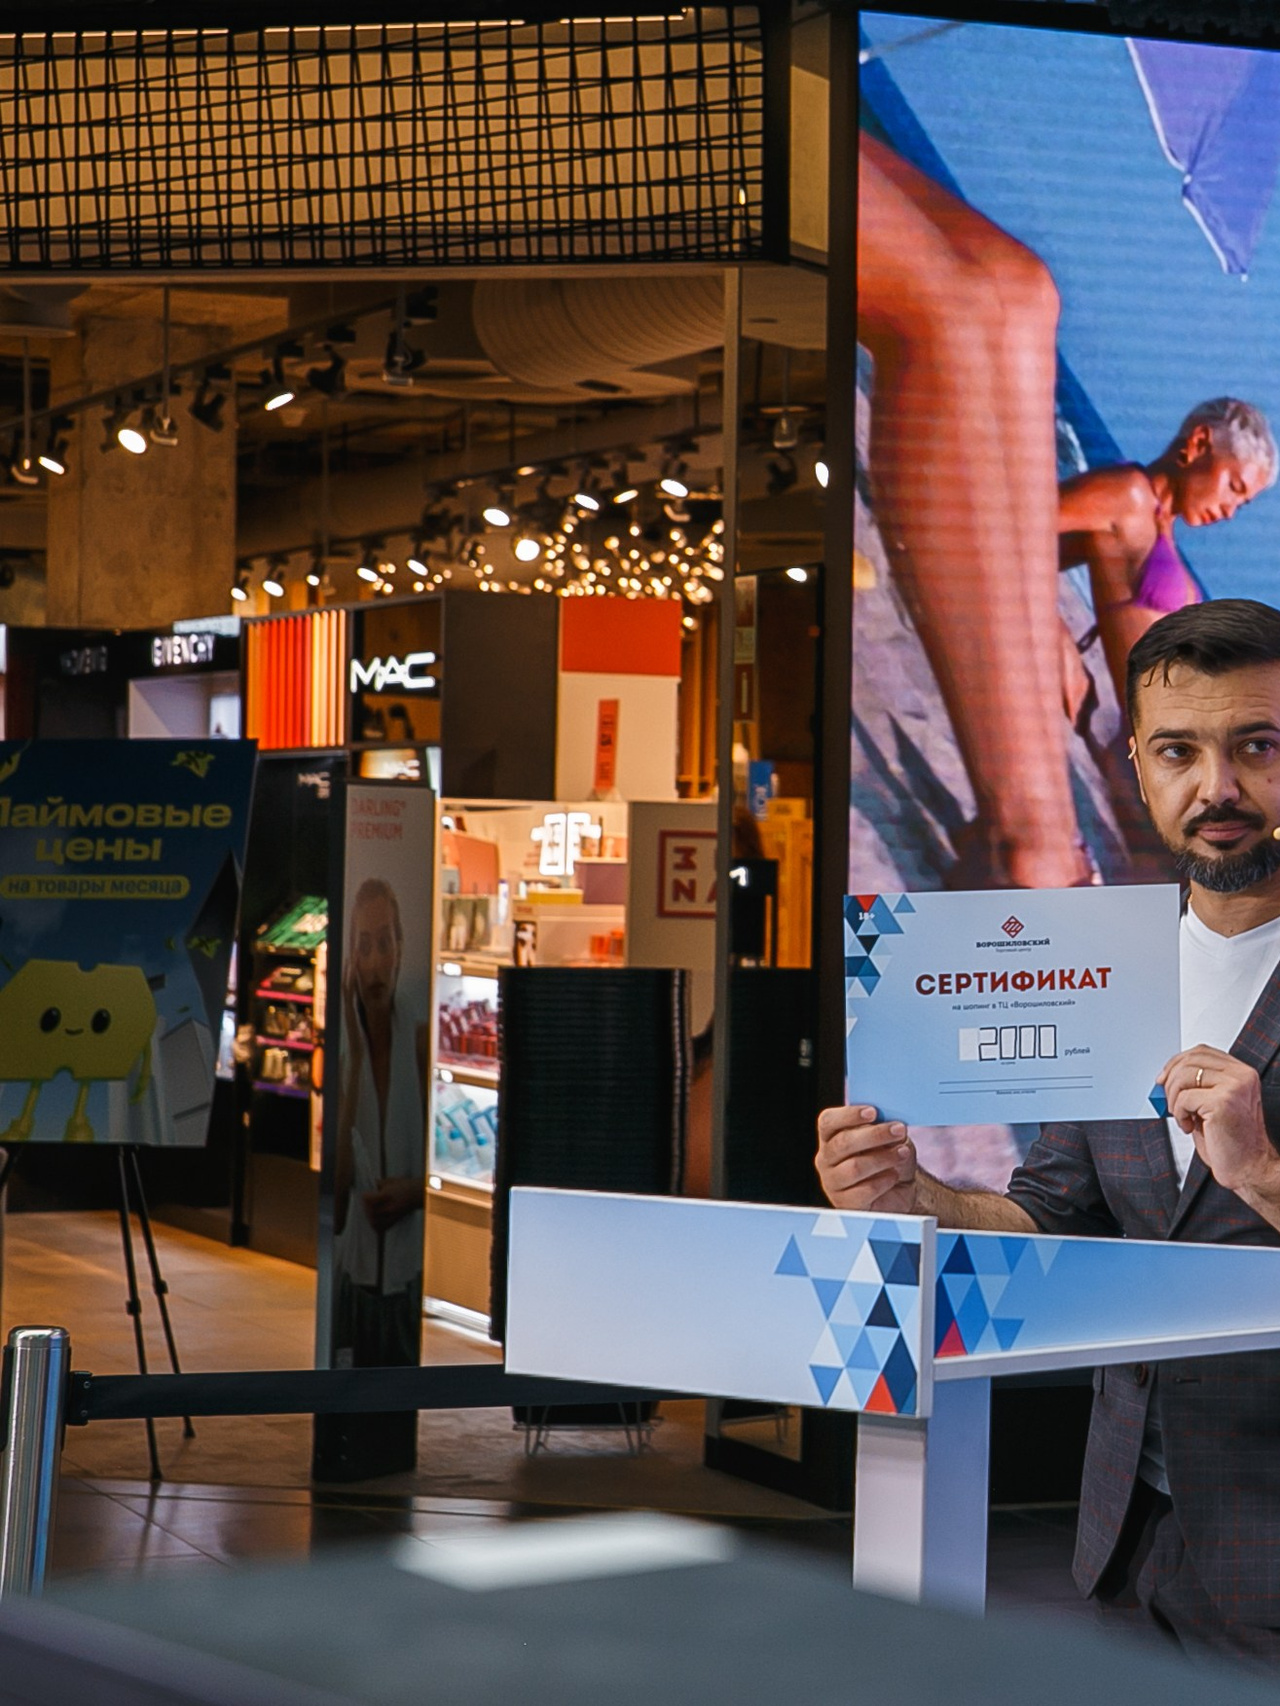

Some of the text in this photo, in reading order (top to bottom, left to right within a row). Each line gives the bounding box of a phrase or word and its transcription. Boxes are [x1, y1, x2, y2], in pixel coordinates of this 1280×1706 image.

[35, 837, 162, 865] цены
[8, 880, 182, 897] на товары месяца
[976, 938, 1051, 948] ВОРОШИЛОВСКИЙ
[915, 966, 1112, 995] СЕРТИФИКАТ
[998, 1001, 1009, 1009] ТЦ
[1010, 999, 1076, 1009] «Ворошиловский»
[978, 1024, 1058, 1061] 2000
[1064, 1047, 1091, 1056] рублей
